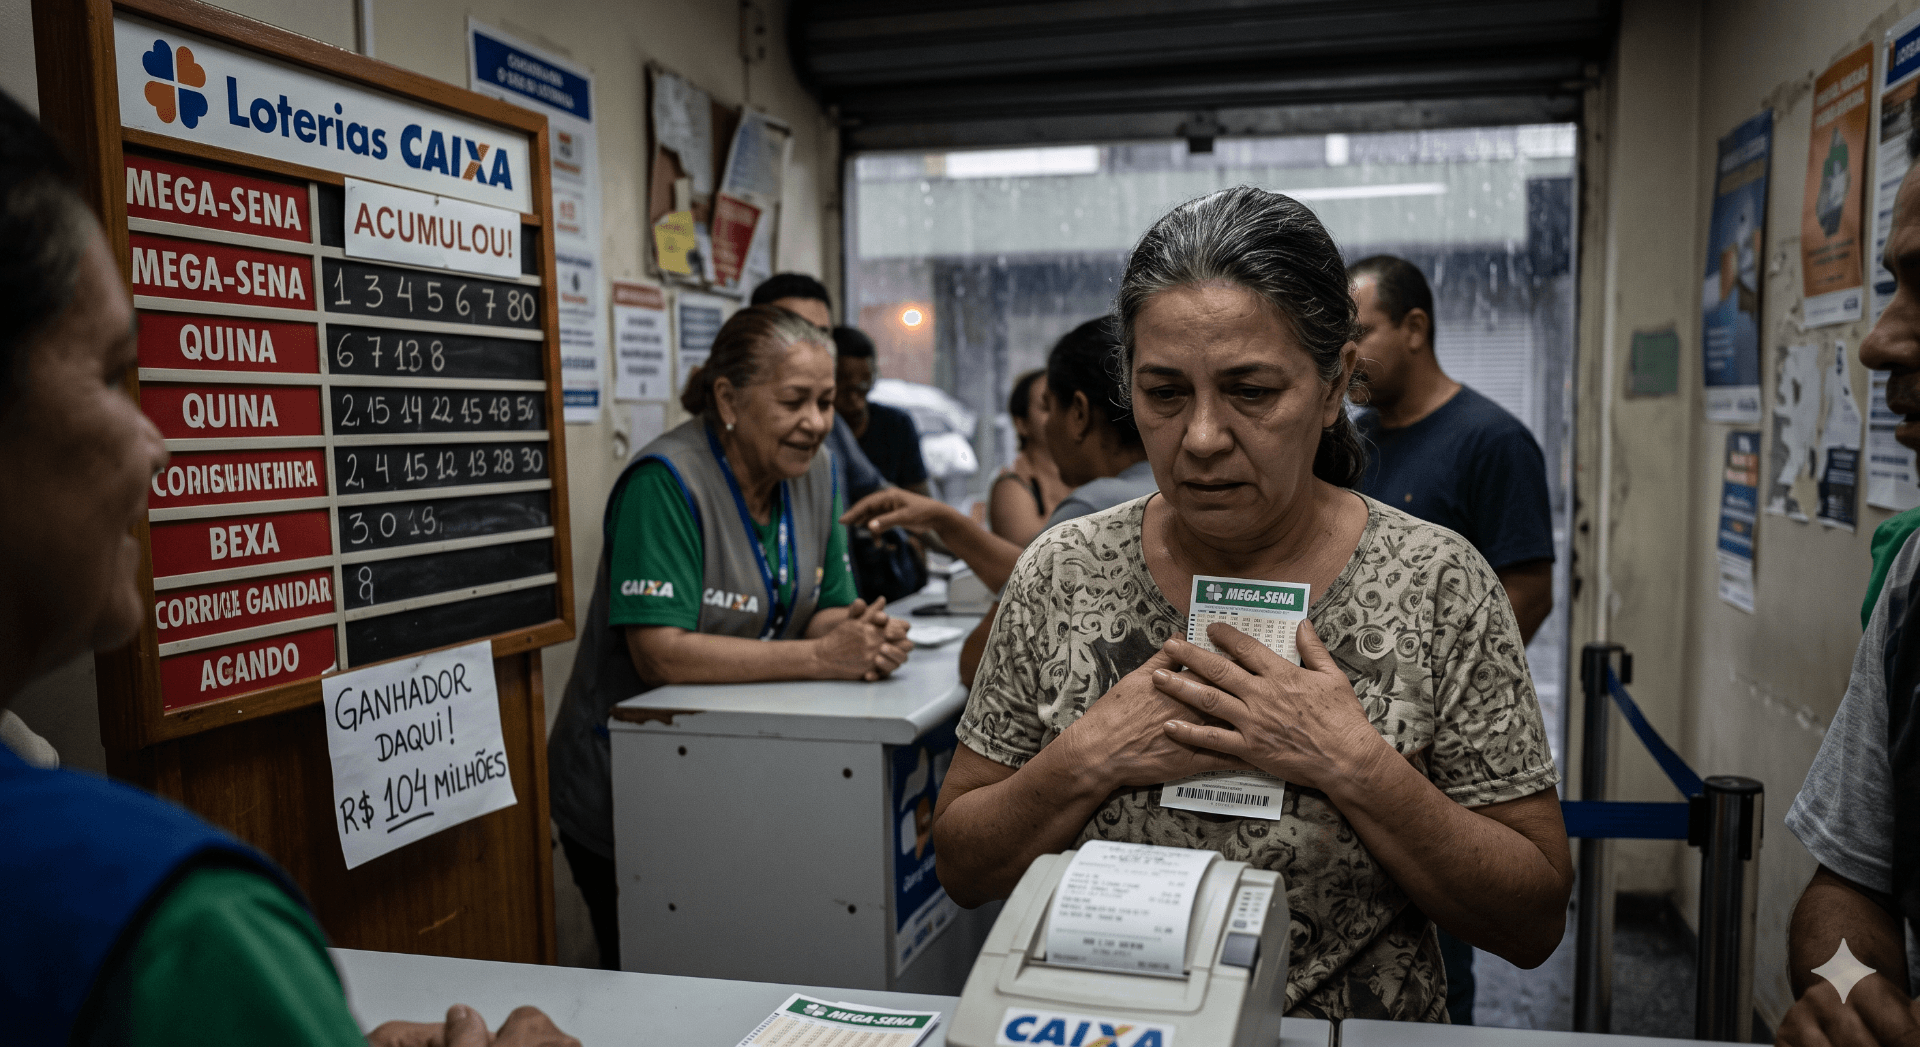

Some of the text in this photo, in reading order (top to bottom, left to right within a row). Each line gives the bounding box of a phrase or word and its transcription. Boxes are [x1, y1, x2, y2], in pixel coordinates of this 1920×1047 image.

[226, 75, 387, 161] Loterias
[399, 124, 514, 191] CAIXA
[126, 167, 302, 231] MEGA-SENA
[353, 202, 513, 259] ACUMULOU!
[132, 247, 306, 301] MEGA-SENA
[334, 267, 351, 306] 1
[364, 274, 383, 308] 3
[397, 276, 413, 313] 4
[427, 281, 443, 312] 5
[456, 284, 470, 316] 6
[482, 288, 496, 319] 7
[507, 290, 536, 322] 80
[179, 323, 277, 364] QUINA
[337, 333, 354, 368] 6
[367, 336, 383, 368] 7
[430, 340, 445, 372] 8
[182, 393, 279, 430] QUINA
[367, 396, 390, 424] 15
[400, 395, 422, 425] 14
[430, 396, 453, 423] 22
[488, 397, 511, 422] 48
[375, 453, 390, 483] 4
[404, 451, 428, 482] 15
[436, 451, 458, 480] 12
[467, 449, 487, 477] 13
[493, 448, 515, 474] 28
[520, 447, 543, 473] 30
[209, 521, 280, 560] BEXA
[621, 579, 674, 598] CAIXA
[702, 588, 759, 614] CAIXA
[1225, 587, 1295, 606] MEGA-SENA
[200, 642, 300, 692] AGANDO
[335, 663, 472, 732] GANHADOR
[375, 705, 455, 762] DAQUI!
[340, 790, 374, 834] R$
[384, 768, 428, 823] 104
[827, 1010, 917, 1027] MEGA-SENA
[1004, 1013, 1164, 1047] CAIXA
